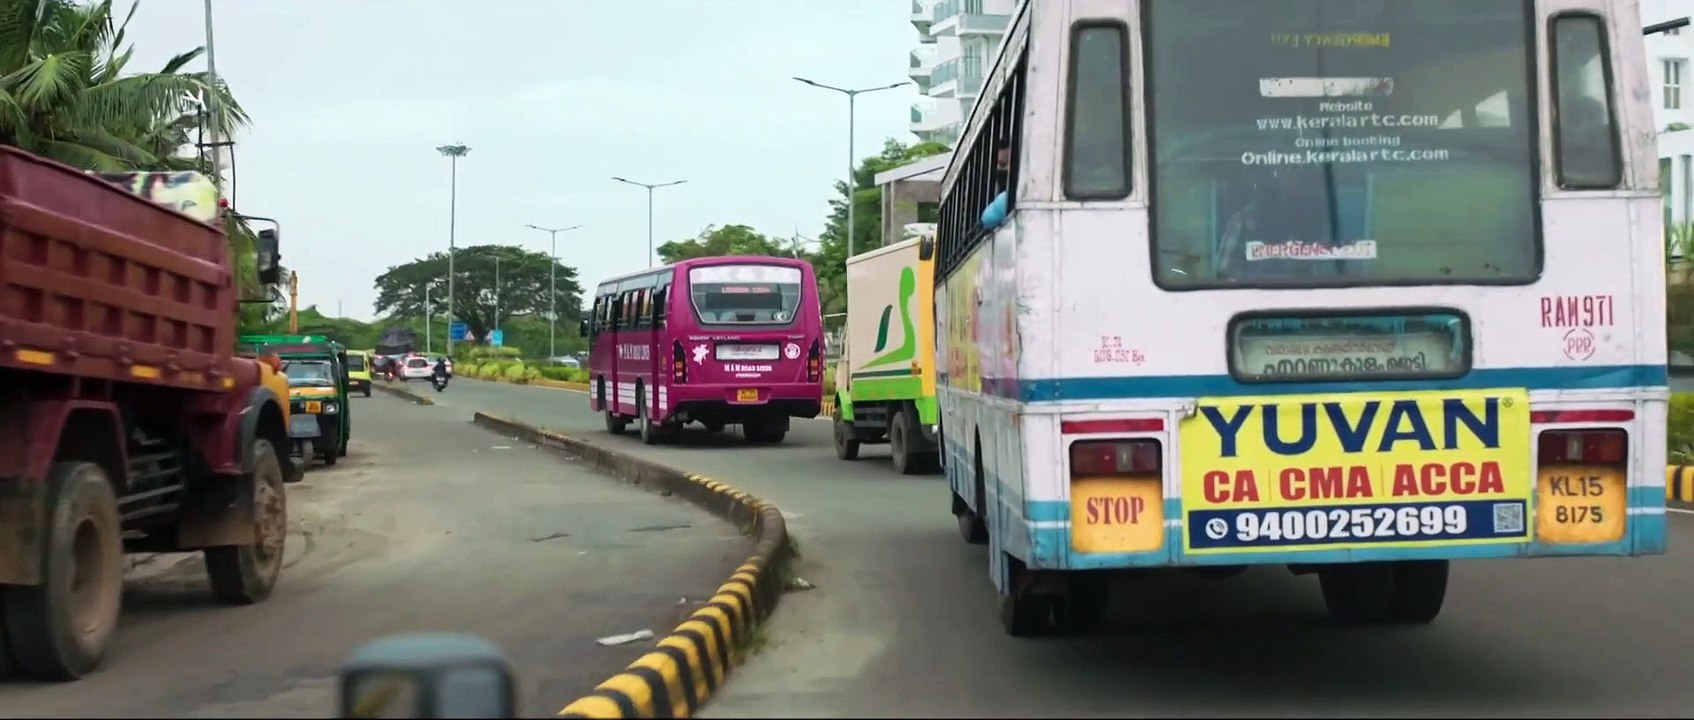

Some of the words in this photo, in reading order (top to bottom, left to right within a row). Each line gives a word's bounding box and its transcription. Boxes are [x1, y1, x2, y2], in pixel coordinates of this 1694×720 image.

[1255, 114, 1439, 130] www.keralartc.com
[1295, 136, 1339, 148] Online
[1343, 134, 1401, 147] booking
[1200, 397, 1501, 458] YUVAN
[1203, 469, 1260, 503] CA
[1279, 465, 1373, 501] CMA
[1392, 461, 1505, 497] ACCA
[1550, 476, 1604, 497] KL15
[1086, 496, 1144, 525] STOP
[1235, 504, 1468, 542] 9400252699
[1555, 505, 1603, 524] 8175
